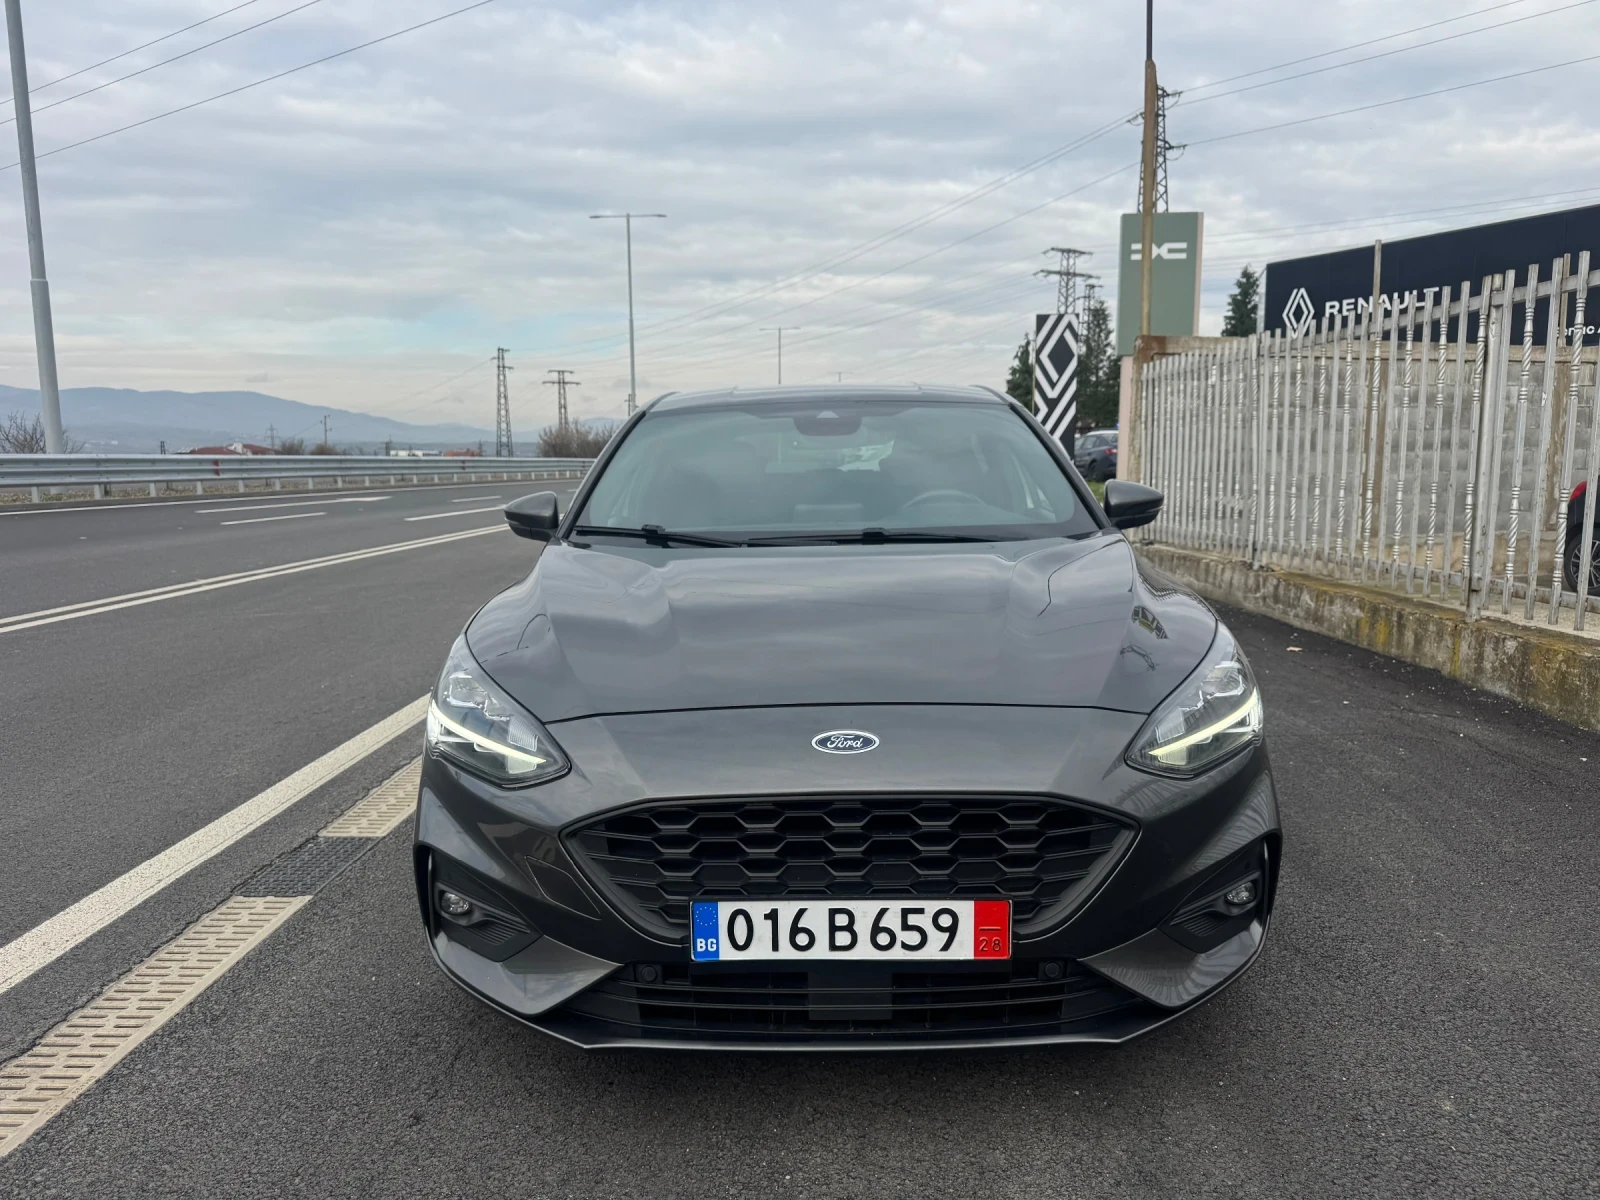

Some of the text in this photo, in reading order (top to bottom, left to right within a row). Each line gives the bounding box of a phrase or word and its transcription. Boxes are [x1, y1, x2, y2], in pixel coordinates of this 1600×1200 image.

[827, 734, 864, 748] Ford
[696, 938, 717, 952] BG
[979, 936, 1002, 952] 28
